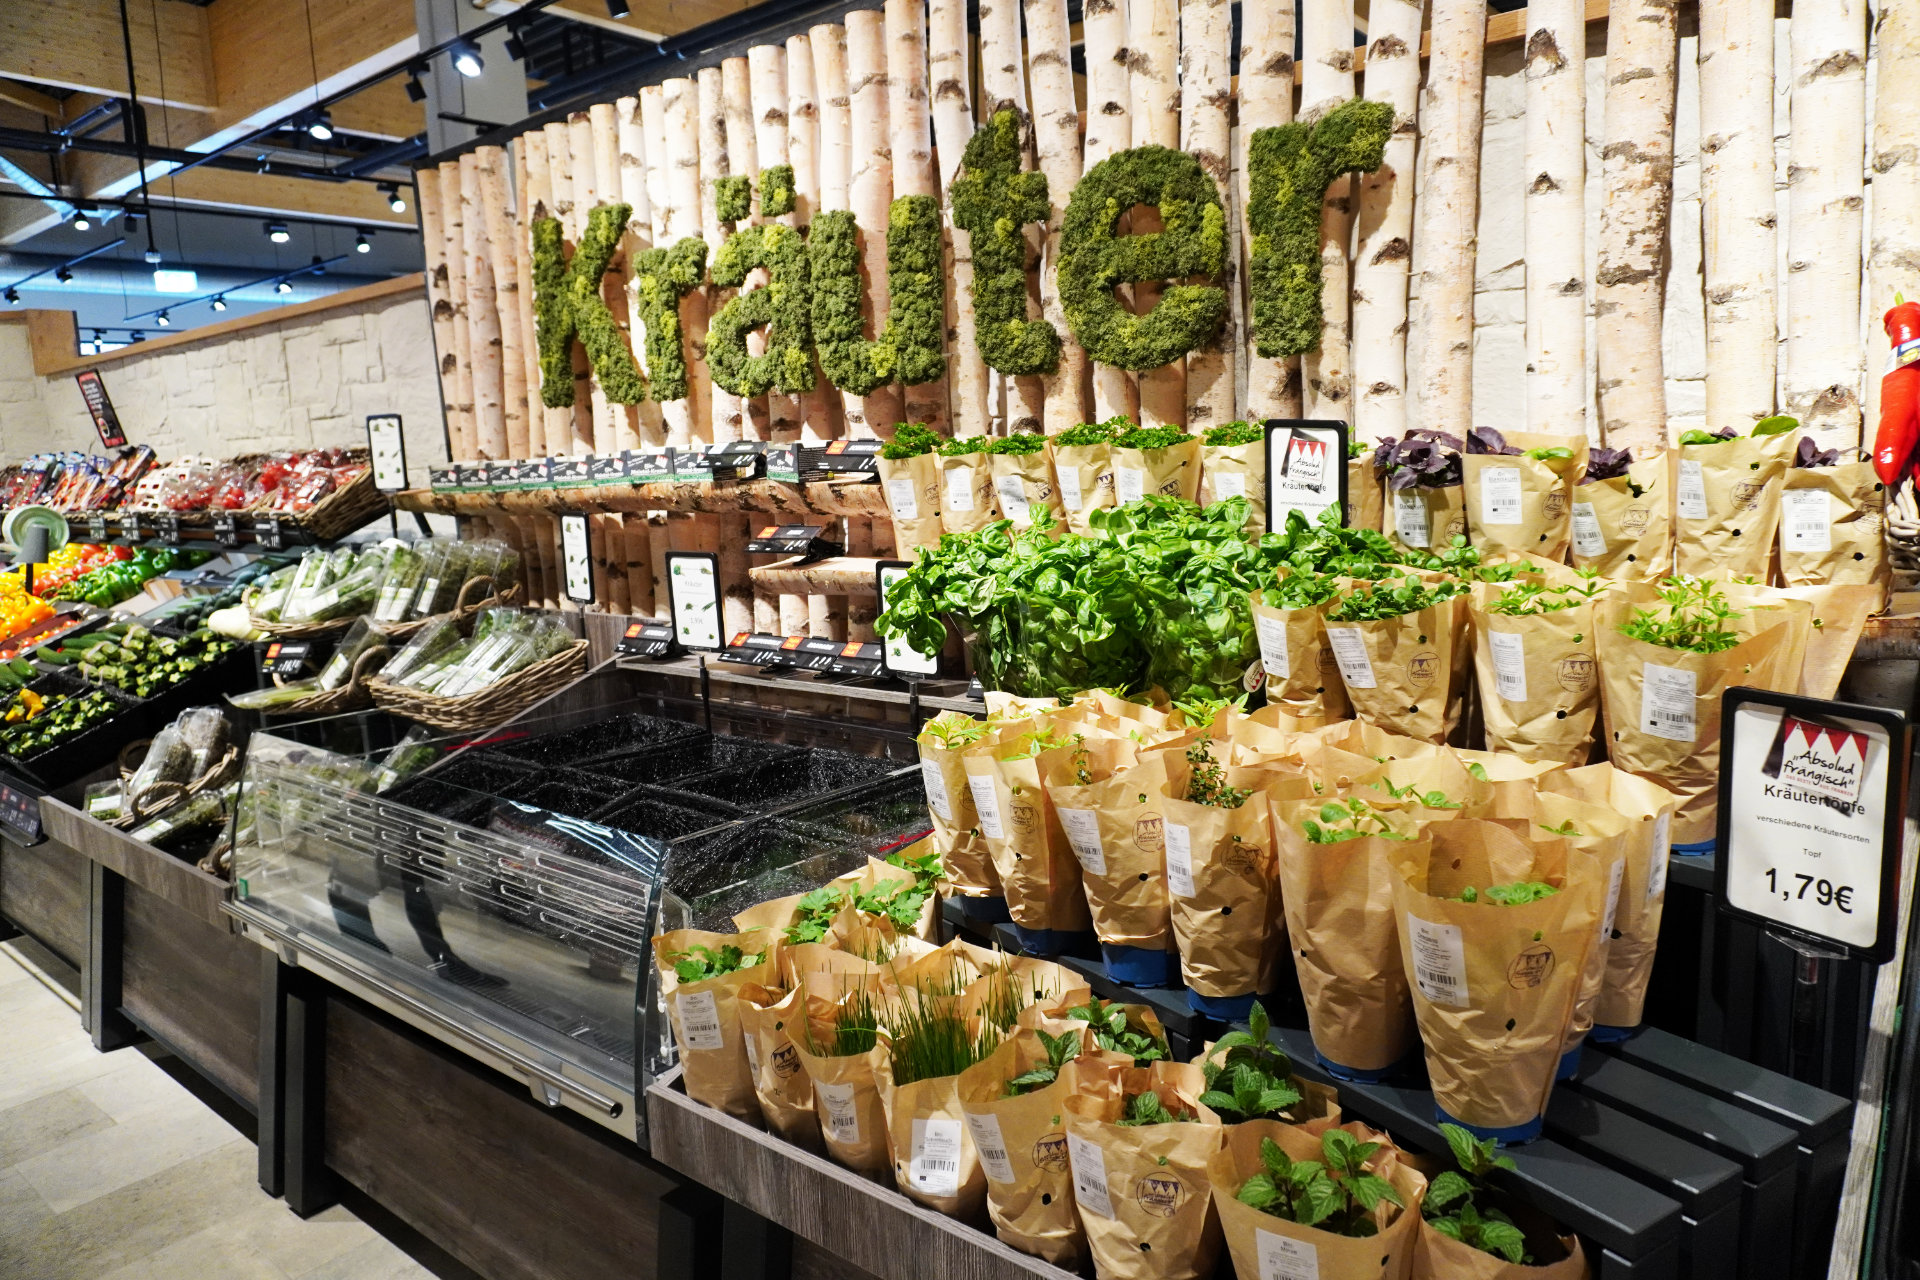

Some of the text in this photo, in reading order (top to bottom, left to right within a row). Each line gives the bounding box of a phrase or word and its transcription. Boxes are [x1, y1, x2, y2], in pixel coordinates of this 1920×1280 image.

[531, 97, 1395, 409] Kräuter
[1756, 814, 1870, 844] verschiedene Kräutersorten
[1803, 848, 1822, 859] Topf
[1765, 867, 1854, 914] 1,79€
